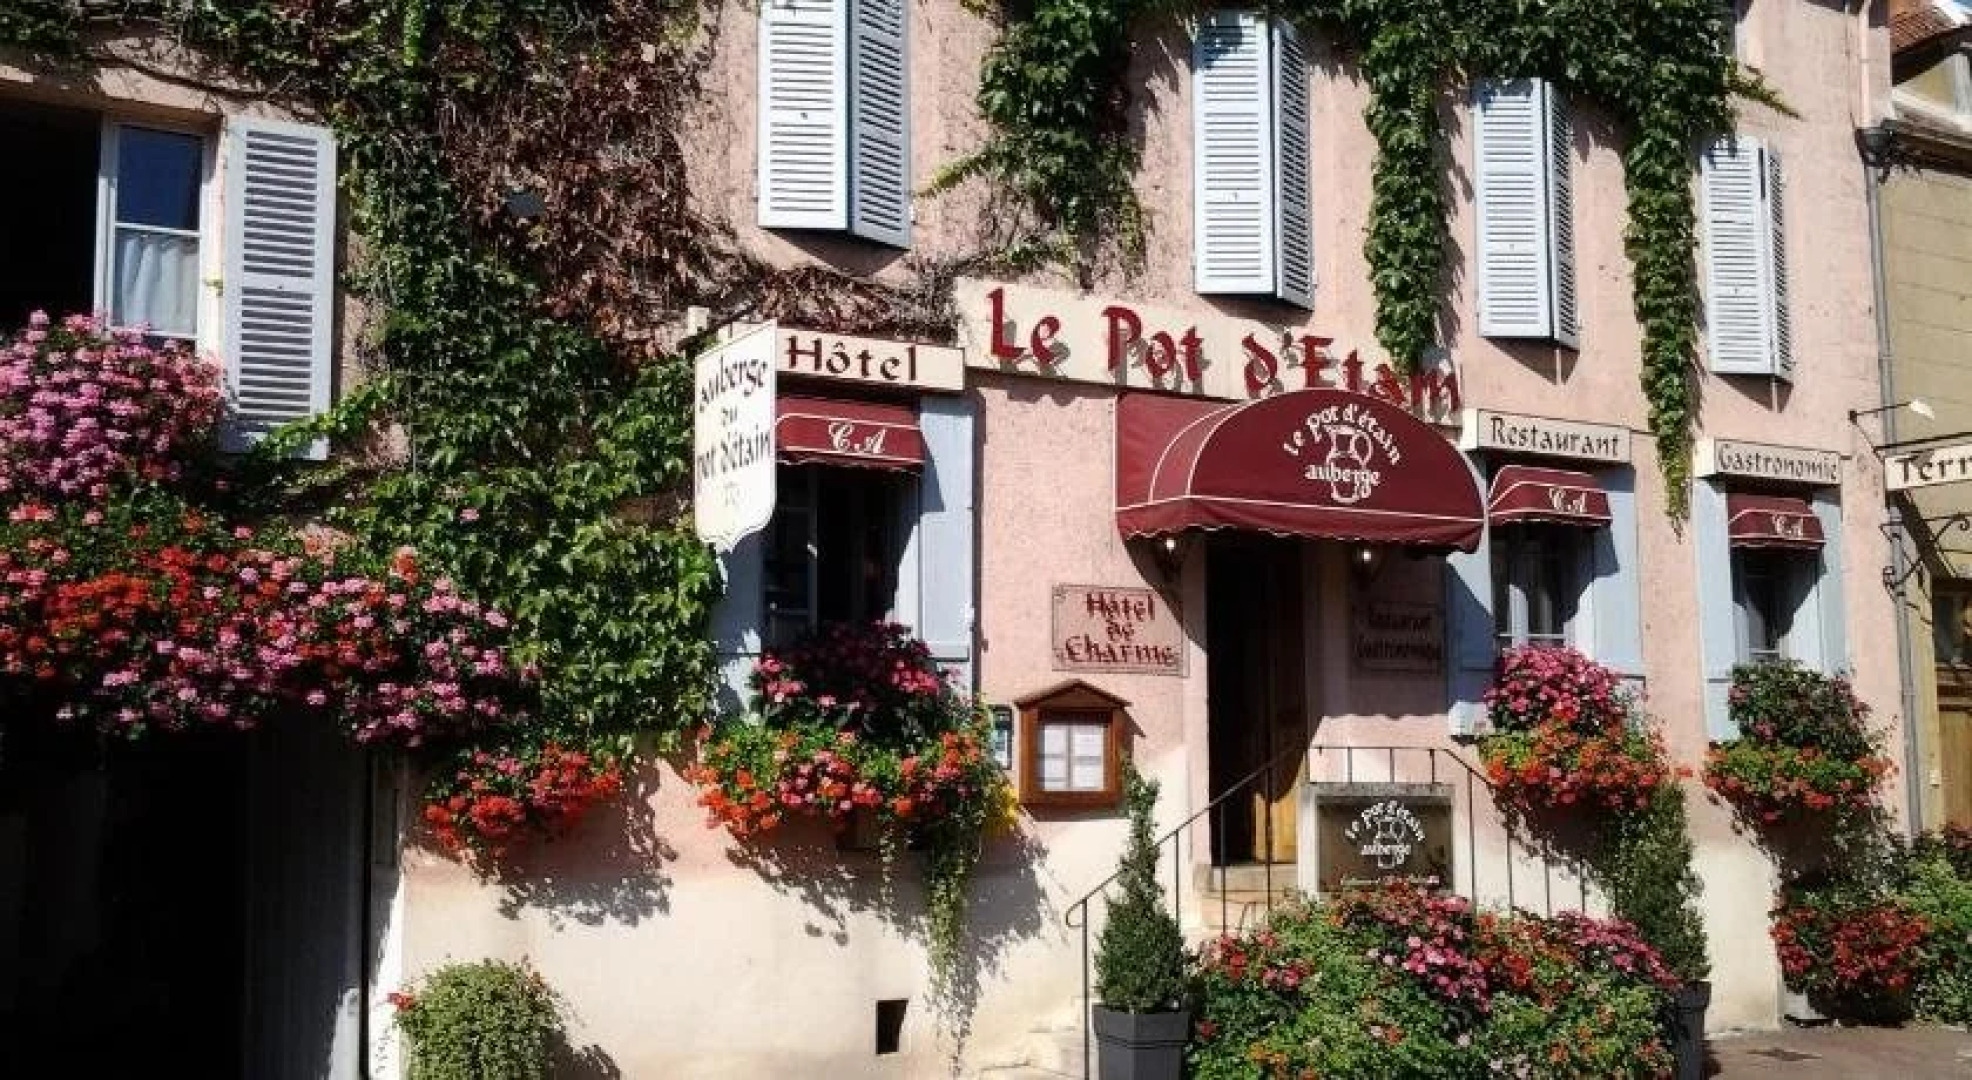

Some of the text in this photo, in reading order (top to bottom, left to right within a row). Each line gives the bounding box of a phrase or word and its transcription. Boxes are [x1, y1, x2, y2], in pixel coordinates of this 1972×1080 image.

[987, 287, 1061, 364] Le
[1101, 306, 1204, 381] Pot
[785, 334, 917, 382] Hôtel
[1306, 406, 1339, 443] pot
[1490, 416, 1619, 457] Restaurant
[1305, 462, 1380, 498] auberge
[1718, 443, 1837, 480] Gastronomie
[1065, 633, 1174, 667] Charme
